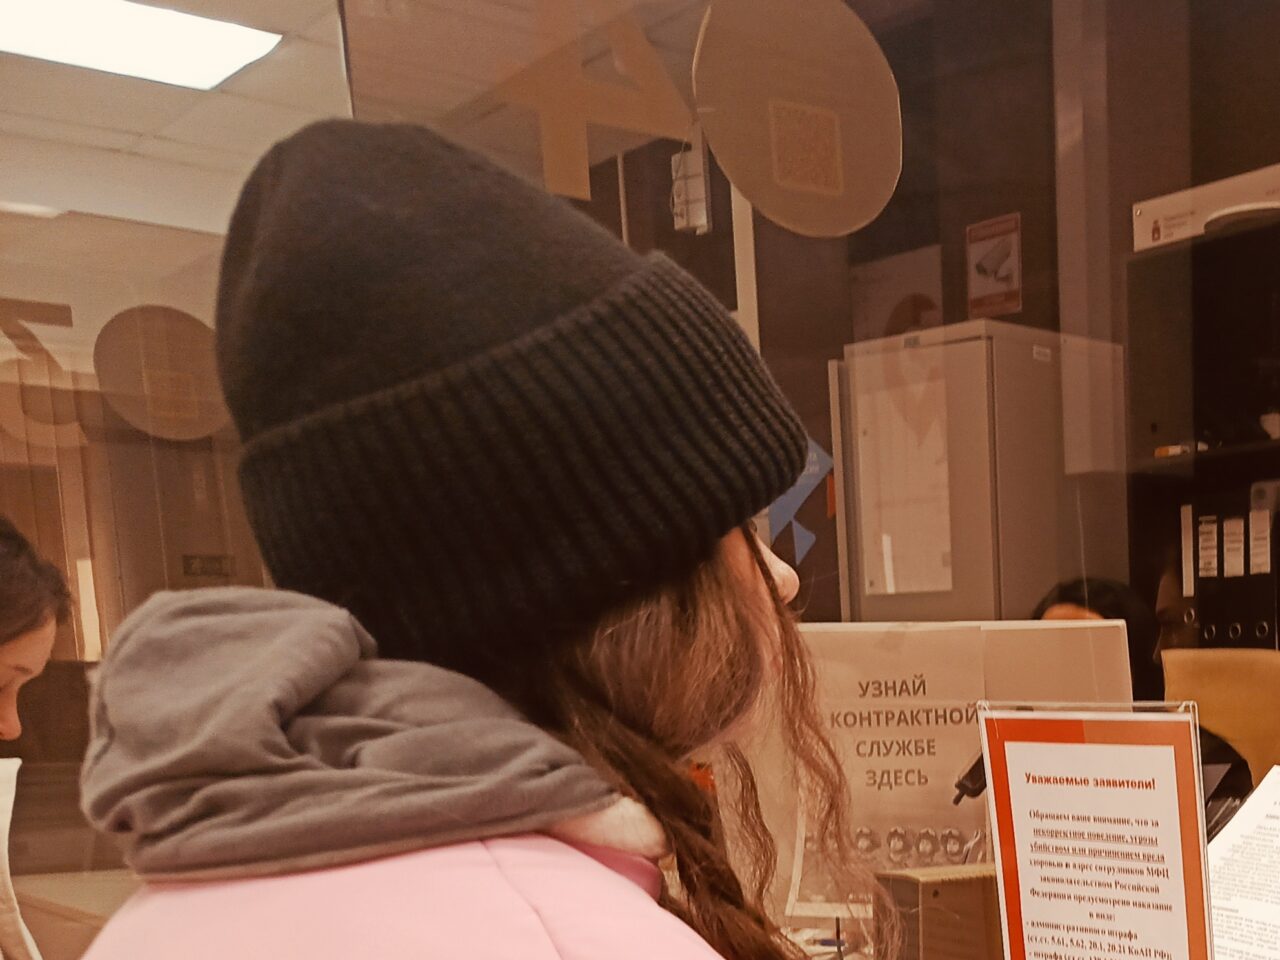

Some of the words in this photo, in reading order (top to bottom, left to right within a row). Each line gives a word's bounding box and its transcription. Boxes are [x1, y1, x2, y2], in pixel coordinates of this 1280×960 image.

[858, 674, 927, 697] УЗНАЙ
[830, 704, 980, 729] КОНТРАКТНОЙ
[856, 738, 936, 757] СЛУЖБЕ
[865, 769, 929, 791] ЗДЕСЬ
[1025, 772, 1090, 786] Уважаемые
[1093, 777, 1156, 790] заявители!
[1029, 809, 1070, 821] Обращаем
[1071, 814, 1091, 823] ваше
[1135, 818, 1148, 827] что
[1033, 828, 1085, 839] некорректное
[1130, 836, 1158, 846] угрозы
[1030, 842, 1070, 854] убийством
[1071, 846, 1086, 854] или
[1088, 848, 1140, 860] причинением
[1142, 853, 1165, 863] вреда
[1029, 858, 1063, 869] здоровью
[1072, 862, 1092, 872] адрес
[1094, 863, 1144, 876] сотрудников
[1146, 867, 1170, 879] МФЦ
[1040, 875, 1112, 889] законодательством
[1114, 880, 1160, 894] Российской
[1029, 888, 1072, 901] Федерации
[1073, 893, 1131, 908] предусмотрено
[1132, 900, 1173, 912] наказание
[1030, 920, 1106, 936] административного
[1107, 929, 1138, 941] штрафа
